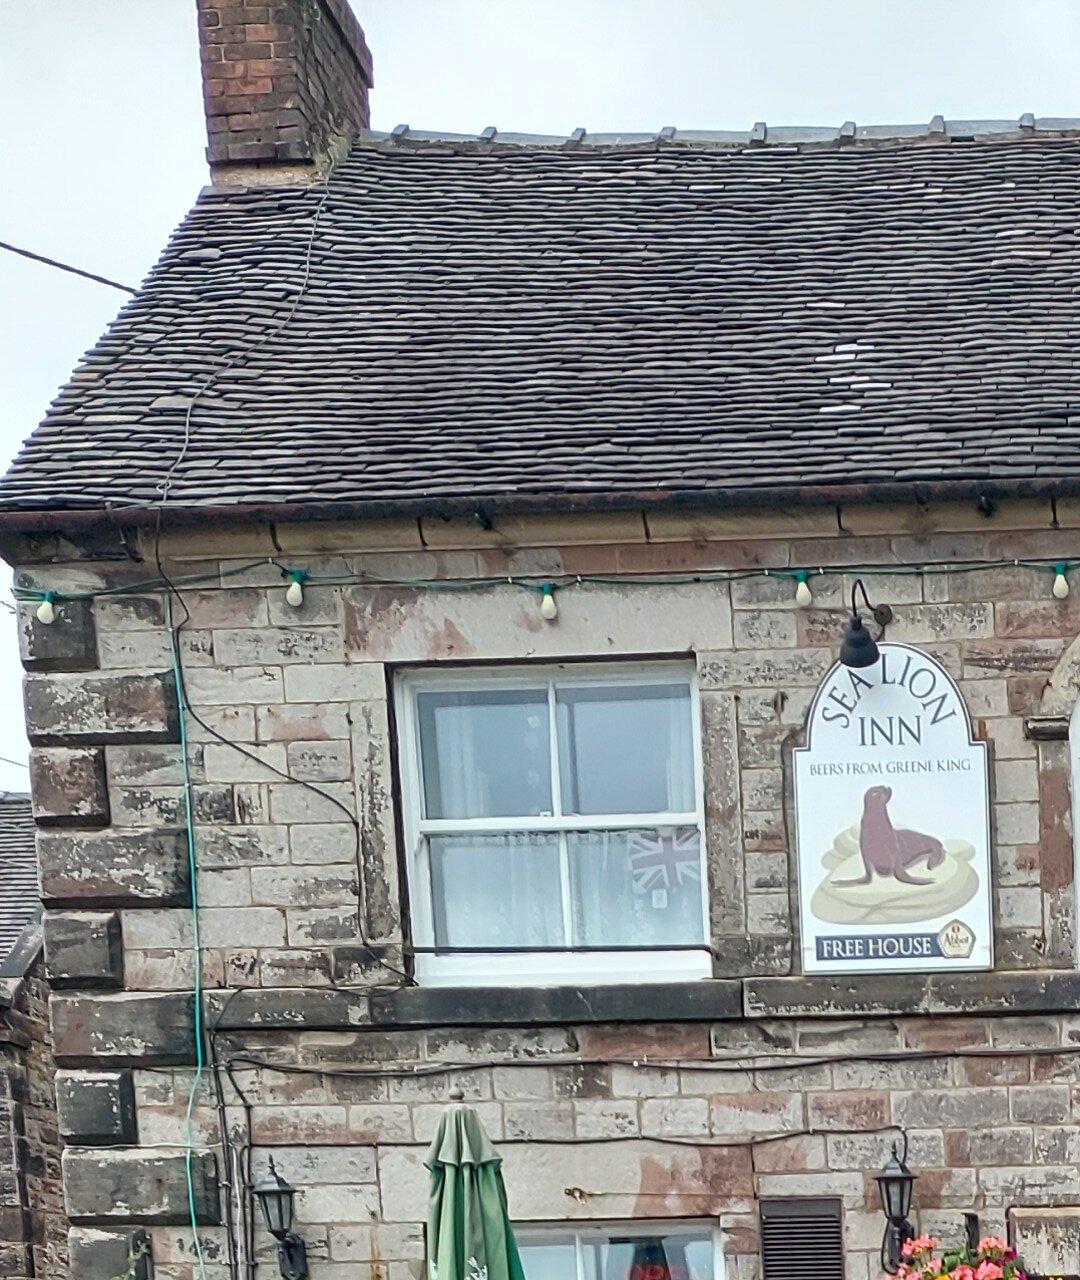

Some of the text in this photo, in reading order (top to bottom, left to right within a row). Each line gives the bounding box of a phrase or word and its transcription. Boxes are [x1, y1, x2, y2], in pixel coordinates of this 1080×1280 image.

[822, 653, 957, 729] SEA LION
[858, 715, 921, 746] INN
[810, 759, 971, 776] BEERS FROM GREENE KING
[822, 937, 932, 958] FREE HOUSE
